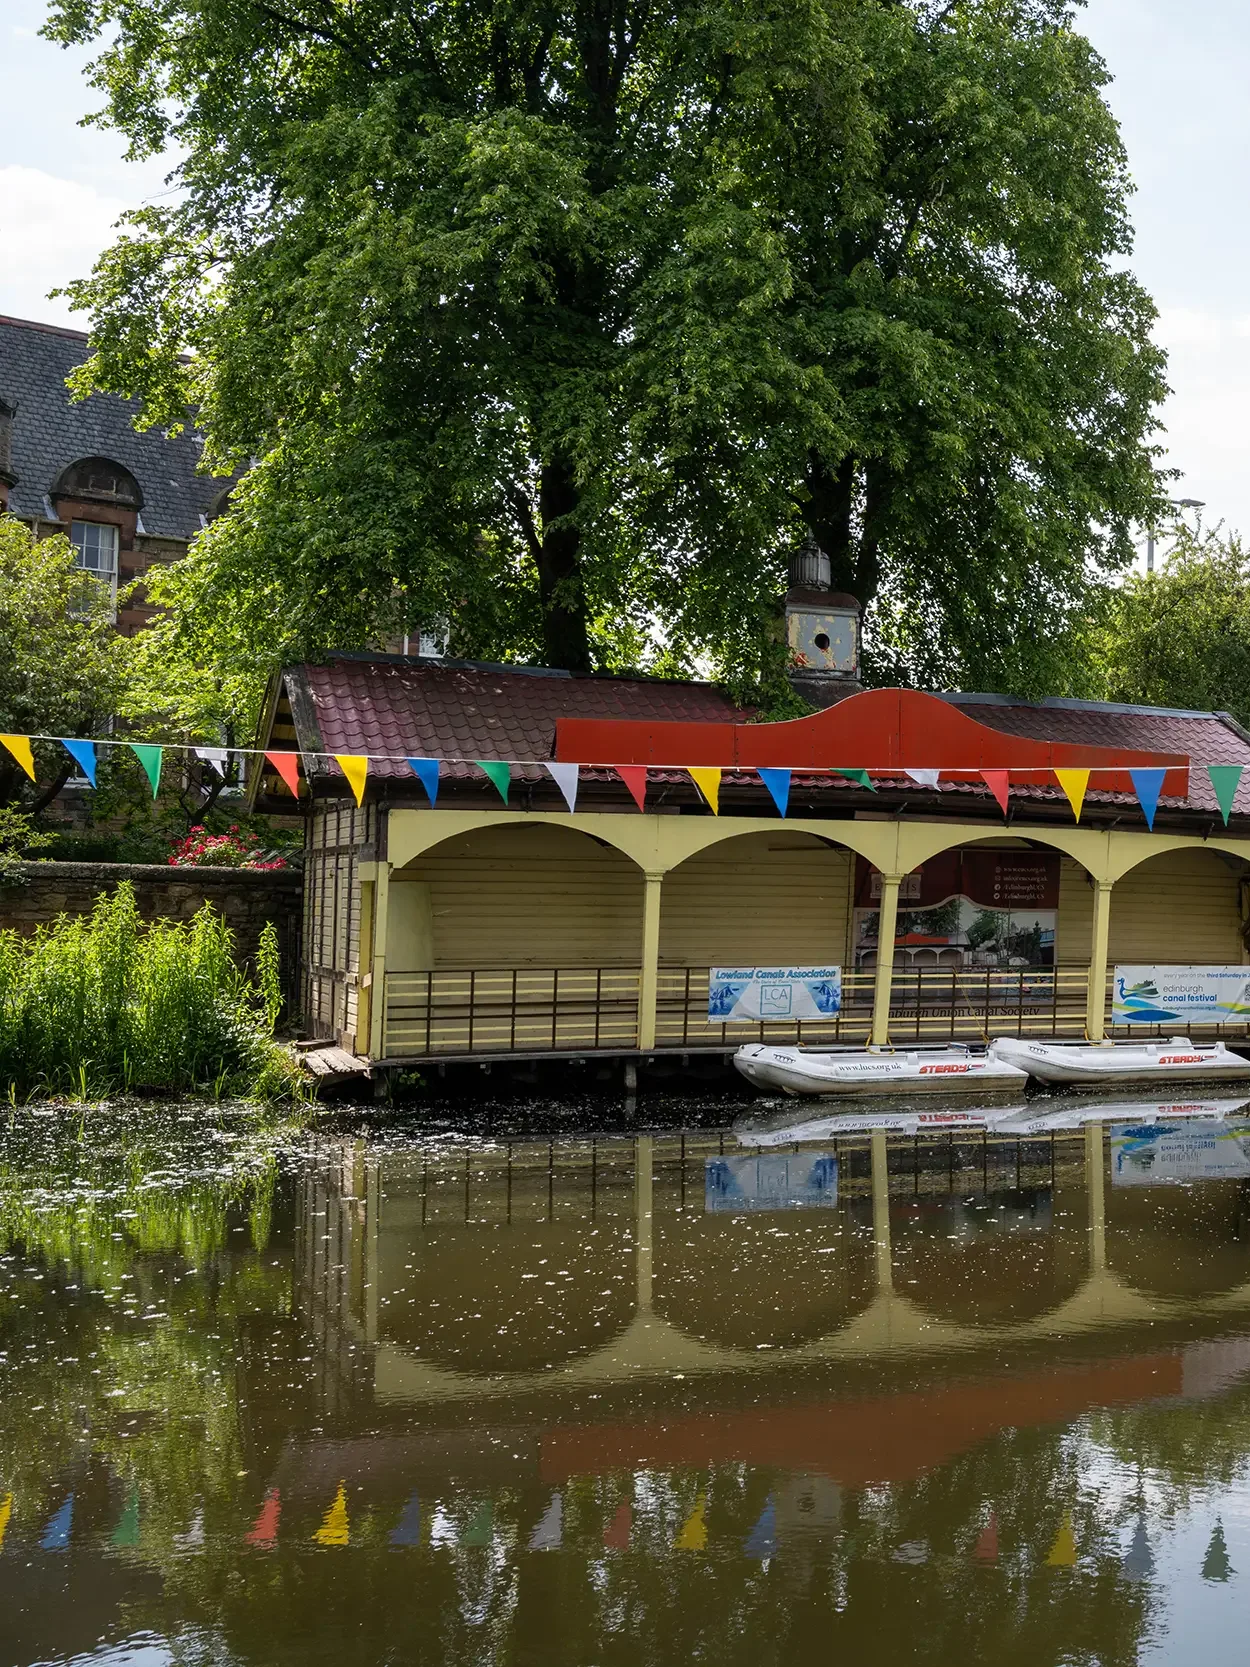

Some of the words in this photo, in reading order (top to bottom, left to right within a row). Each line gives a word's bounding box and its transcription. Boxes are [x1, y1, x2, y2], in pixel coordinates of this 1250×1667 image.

[716, 970, 753, 979] Lowland
[755, 969, 785, 979] Canals
[786, 969, 836, 978] Association
[764, 988, 788, 1000] LCA
[1163, 985, 1203, 994] edinburgh
[1159, 1055, 1201, 1064] STEADY
[919, 1064, 967, 1074] STEADY
